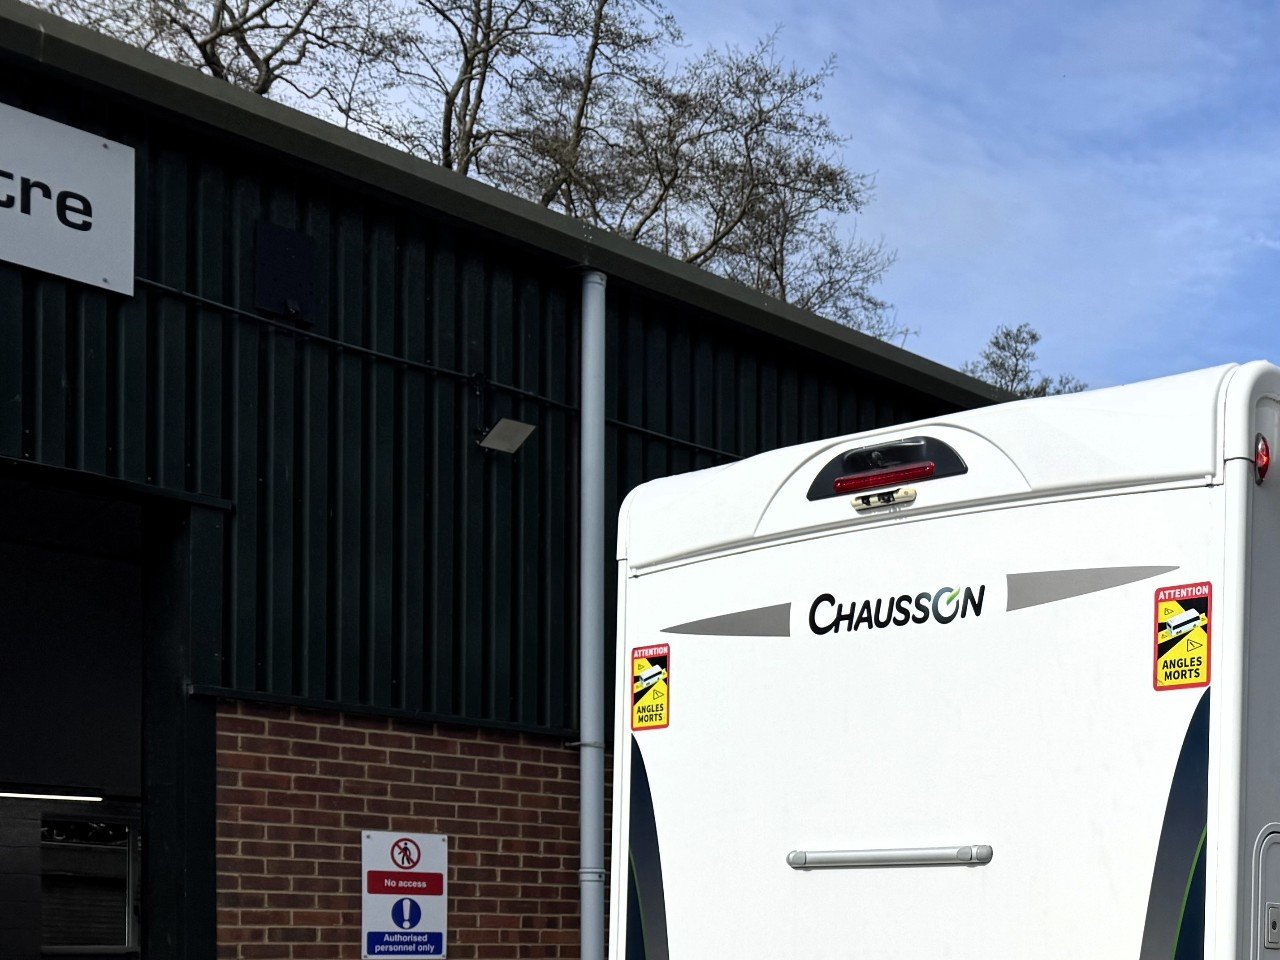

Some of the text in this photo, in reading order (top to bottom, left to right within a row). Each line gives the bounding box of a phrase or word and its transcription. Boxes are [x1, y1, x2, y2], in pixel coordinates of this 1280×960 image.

[1158, 585, 1209, 600] ATTENTION
[808, 585, 986, 635] CHAUSSON
[633, 646, 669, 658] ATTENTION
[1162, 656, 1203, 670] ANGLES
[1164, 668, 1201, 681] MORTS
[636, 703, 664, 714] ANGLES
[637, 713, 663, 723] MORTS
[384, 878, 427, 889] No access
[383, 933, 428, 942] Authorised
[374, 943, 435, 954] personnel only
